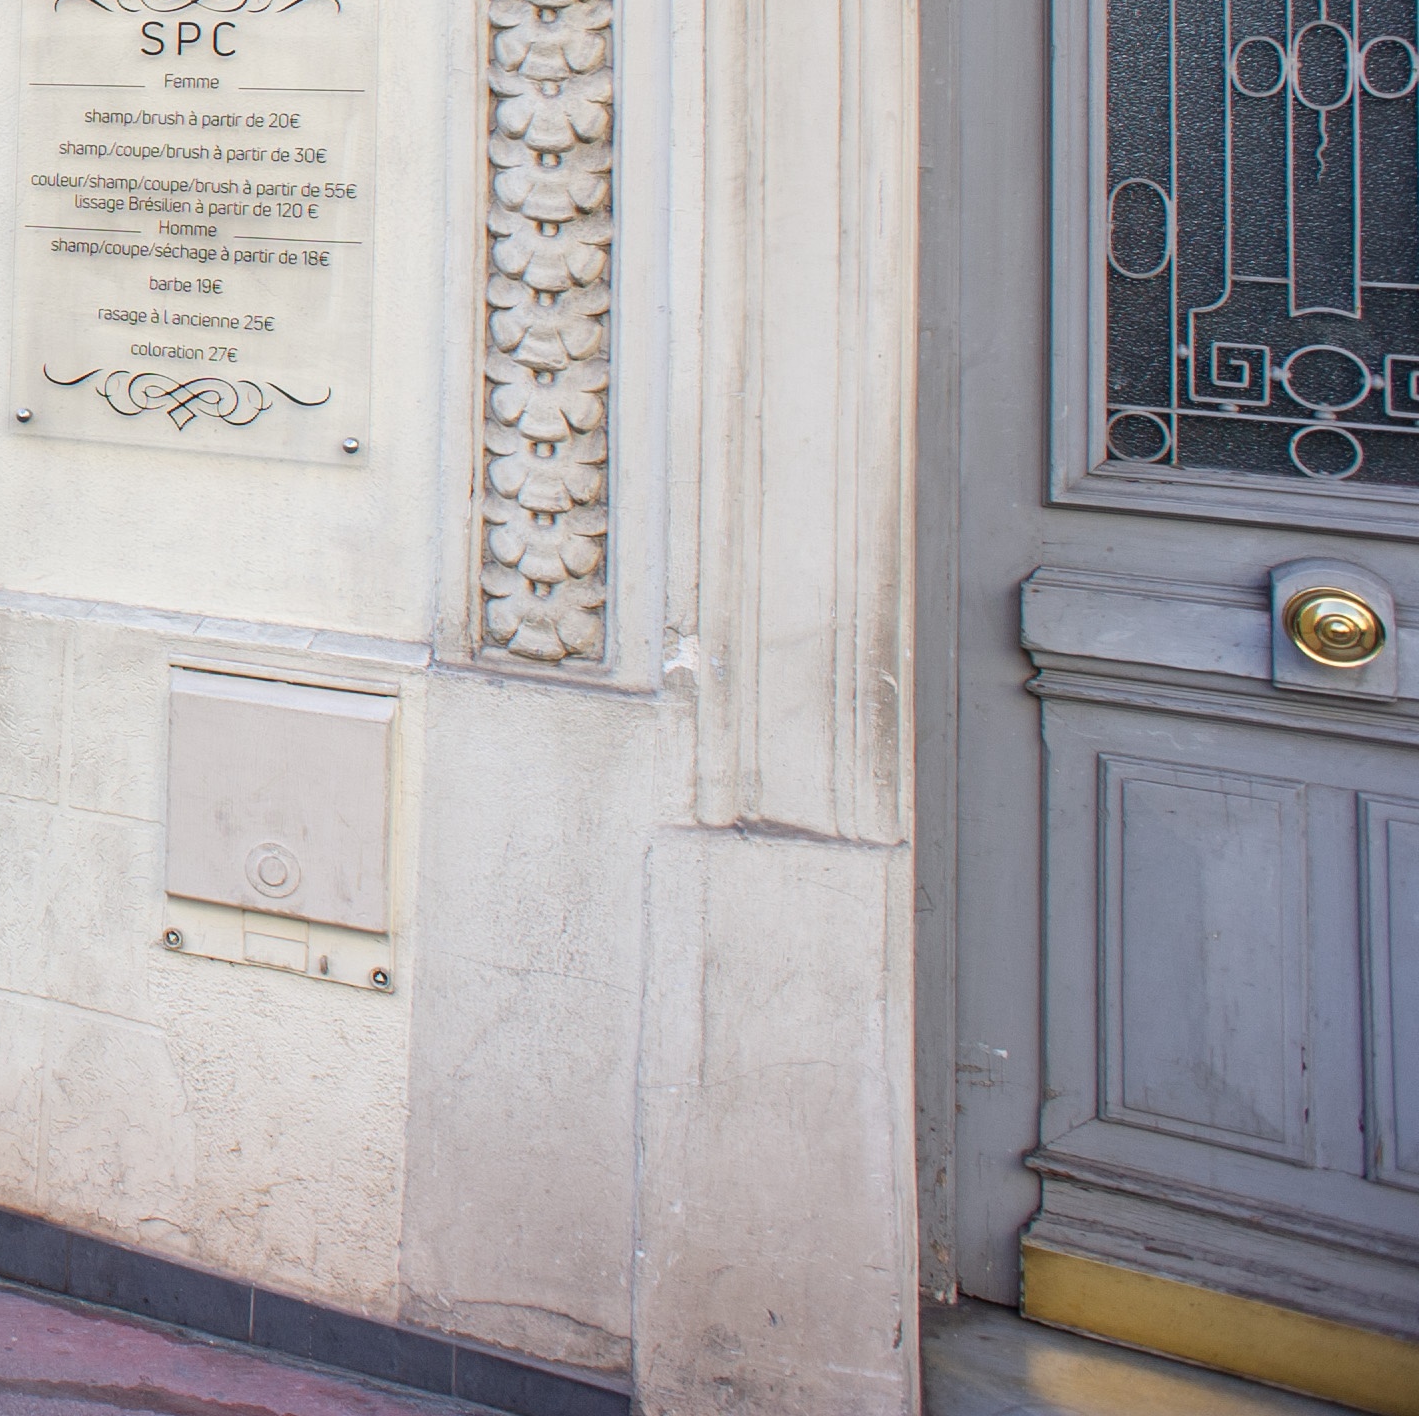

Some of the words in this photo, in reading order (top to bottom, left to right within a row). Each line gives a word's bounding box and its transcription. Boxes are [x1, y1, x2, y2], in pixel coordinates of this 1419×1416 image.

[140, 22, 237, 56] SPC
[164, 73, 220, 89] Femme
[84, 109, 184, 126] shamp./brush
[189, 111, 197, 126] à
[201, 113, 242, 129] partir
[245, 113, 265, 128] de
[268, 113, 301, 129] 20€
[213, 145, 222, 160] à
[226, 147, 267, 163] partir
[270, 148, 290, 162] de
[294, 148, 327, 164] 30€
[31, 172, 239, 194] couleur/shamp/coupe/brush
[242, 179, 252, 195] à
[256, 182, 297, 198] partir
[301, 183, 320, 197] de
[324, 183, 357, 199] 55€
[74, 194, 124, 213] lissage
[128, 196, 191, 213] Brésilien
[195, 199, 204, 214] à
[208, 201, 249, 217] partir
[252, 201, 272, 217] de
[276, 202, 303, 218] 120
[307, 203, 320, 219] €
[158, 220, 217, 237] Homme
[51, 238, 217, 263] shamp/coupe/séchage
[220, 245, 230, 262] à
[233, 247, 275, 264] partir
[278, 249, 298, 265] de
[302, 250, 330, 267] 18€
[149, 275, 192, 293] barbe
[196, 278, 224, 294] 19€
[97, 308, 147, 326] rasage
[150, 309, 160, 324] à
[243, 315, 276, 332] 25€
[130, 341, 204, 361] coloration
[208, 346, 239, 363] 27€
